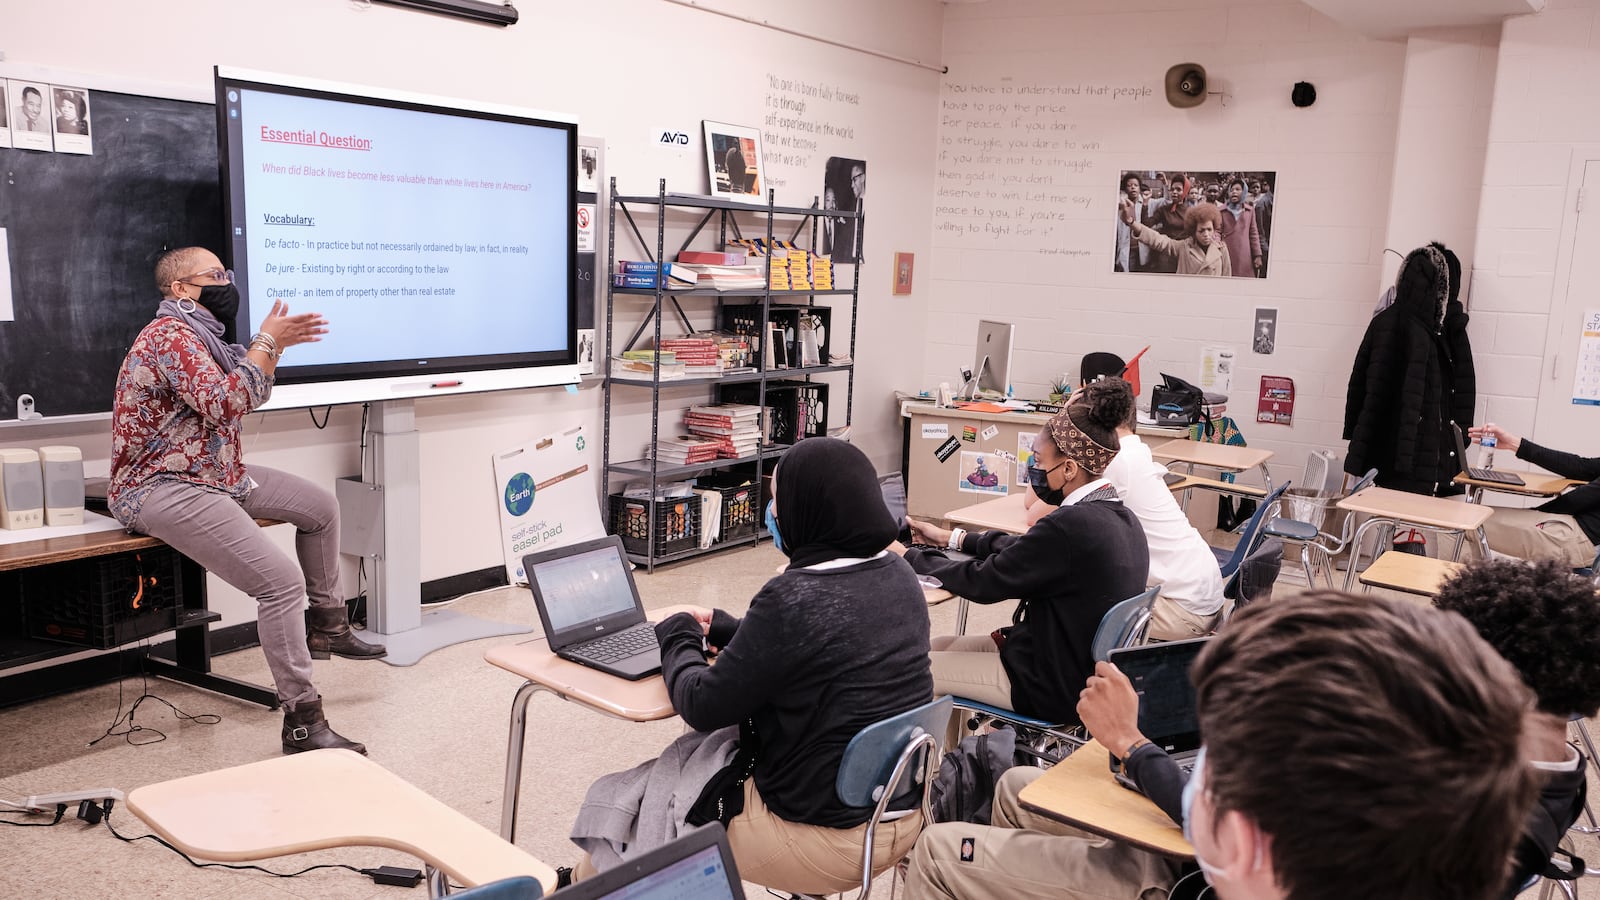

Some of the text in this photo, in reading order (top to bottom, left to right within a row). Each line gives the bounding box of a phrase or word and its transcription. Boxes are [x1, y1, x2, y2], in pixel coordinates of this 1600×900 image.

[780, 80, 792, 90] one
[794, 80, 800, 93] is
[802, 81, 818, 97] born
[1017, 85, 1080, 94] understand
[1086, 85, 1110, 95] that
[1114, 86, 1152, 100] people
[780, 94, 806, 116] through
[943, 100, 1066, 116] have to pay the price
[815, 121, 821, 134] in
[824, 122, 834, 136] the
[836, 125, 854, 139] world
[943, 115, 962, 127] for
[1026, 122, 1045, 134] you
[261, 125, 373, 150] Essential Question:
[765, 132, 779, 146] that
[781, 136, 791, 146] we
[942, 136, 952, 144] to
[1008, 140, 1028, 151] you
[1065, 140, 1076, 149] to
[763, 150, 781, 163] what
[784, 155, 794, 166] we
[953, 155, 972, 167] you
[977, 152, 1001, 164] dare
[1006, 157, 1024, 165] not
[1032, 156, 1042, 166] to
[1047, 157, 1092, 172] struggle
[262, 163, 532, 191] When did Black lives become less valuable than white lives here in America?
[938, 169, 961, 179] then
[1002, 176, 1021, 186] you
[937, 186, 980, 198] deserve
[986, 188, 997, 198] to
[1072, 197, 1092, 208] say
[264, 213, 315, 226] Vocabulary:
[936, 206, 968, 216] peace
[974, 206, 984, 216] to
[970, 224, 980, 232] to
[985, 222, 1009, 240] fight
[264, 238, 276, 248] De
[279, 238, 300, 249] facto
[307, 240, 314, 249] In
[317, 240, 349, 251] practice
[351, 241, 363, 250] but
[366, 242, 378, 250] not
[380, 242, 421, 253] necessarily
[423, 243, 453, 252] ordained
[455, 244, 463, 254] by
[479, 244, 485, 252] in
[487, 244, 501, 254] fact,
[503, 245, 508, 253] in
[510, 245, 528, 256] reality
[266, 263, 277, 273] De
[278, 263, 294, 275] jure
[302, 264, 334, 275] Existing
[336, 264, 346, 275] by
[348, 264, 365, 276] right
[377, 265, 414, 275] according
[424, 264, 436, 273] the
[437, 265, 449, 273] law
[266, 288, 296, 298] Chattel
[316, 288, 334, 296] item
[336, 287, 344, 296] of
[346, 287, 378, 299] property
[380, 287, 399, 296] other
[401, 287, 417, 296] than
[419, 287, 432, 296] real
[510, 488, 530, 503] Earth
[511, 520, 547, 542] self-stick
[512, 523, 563, 553] easel pad
